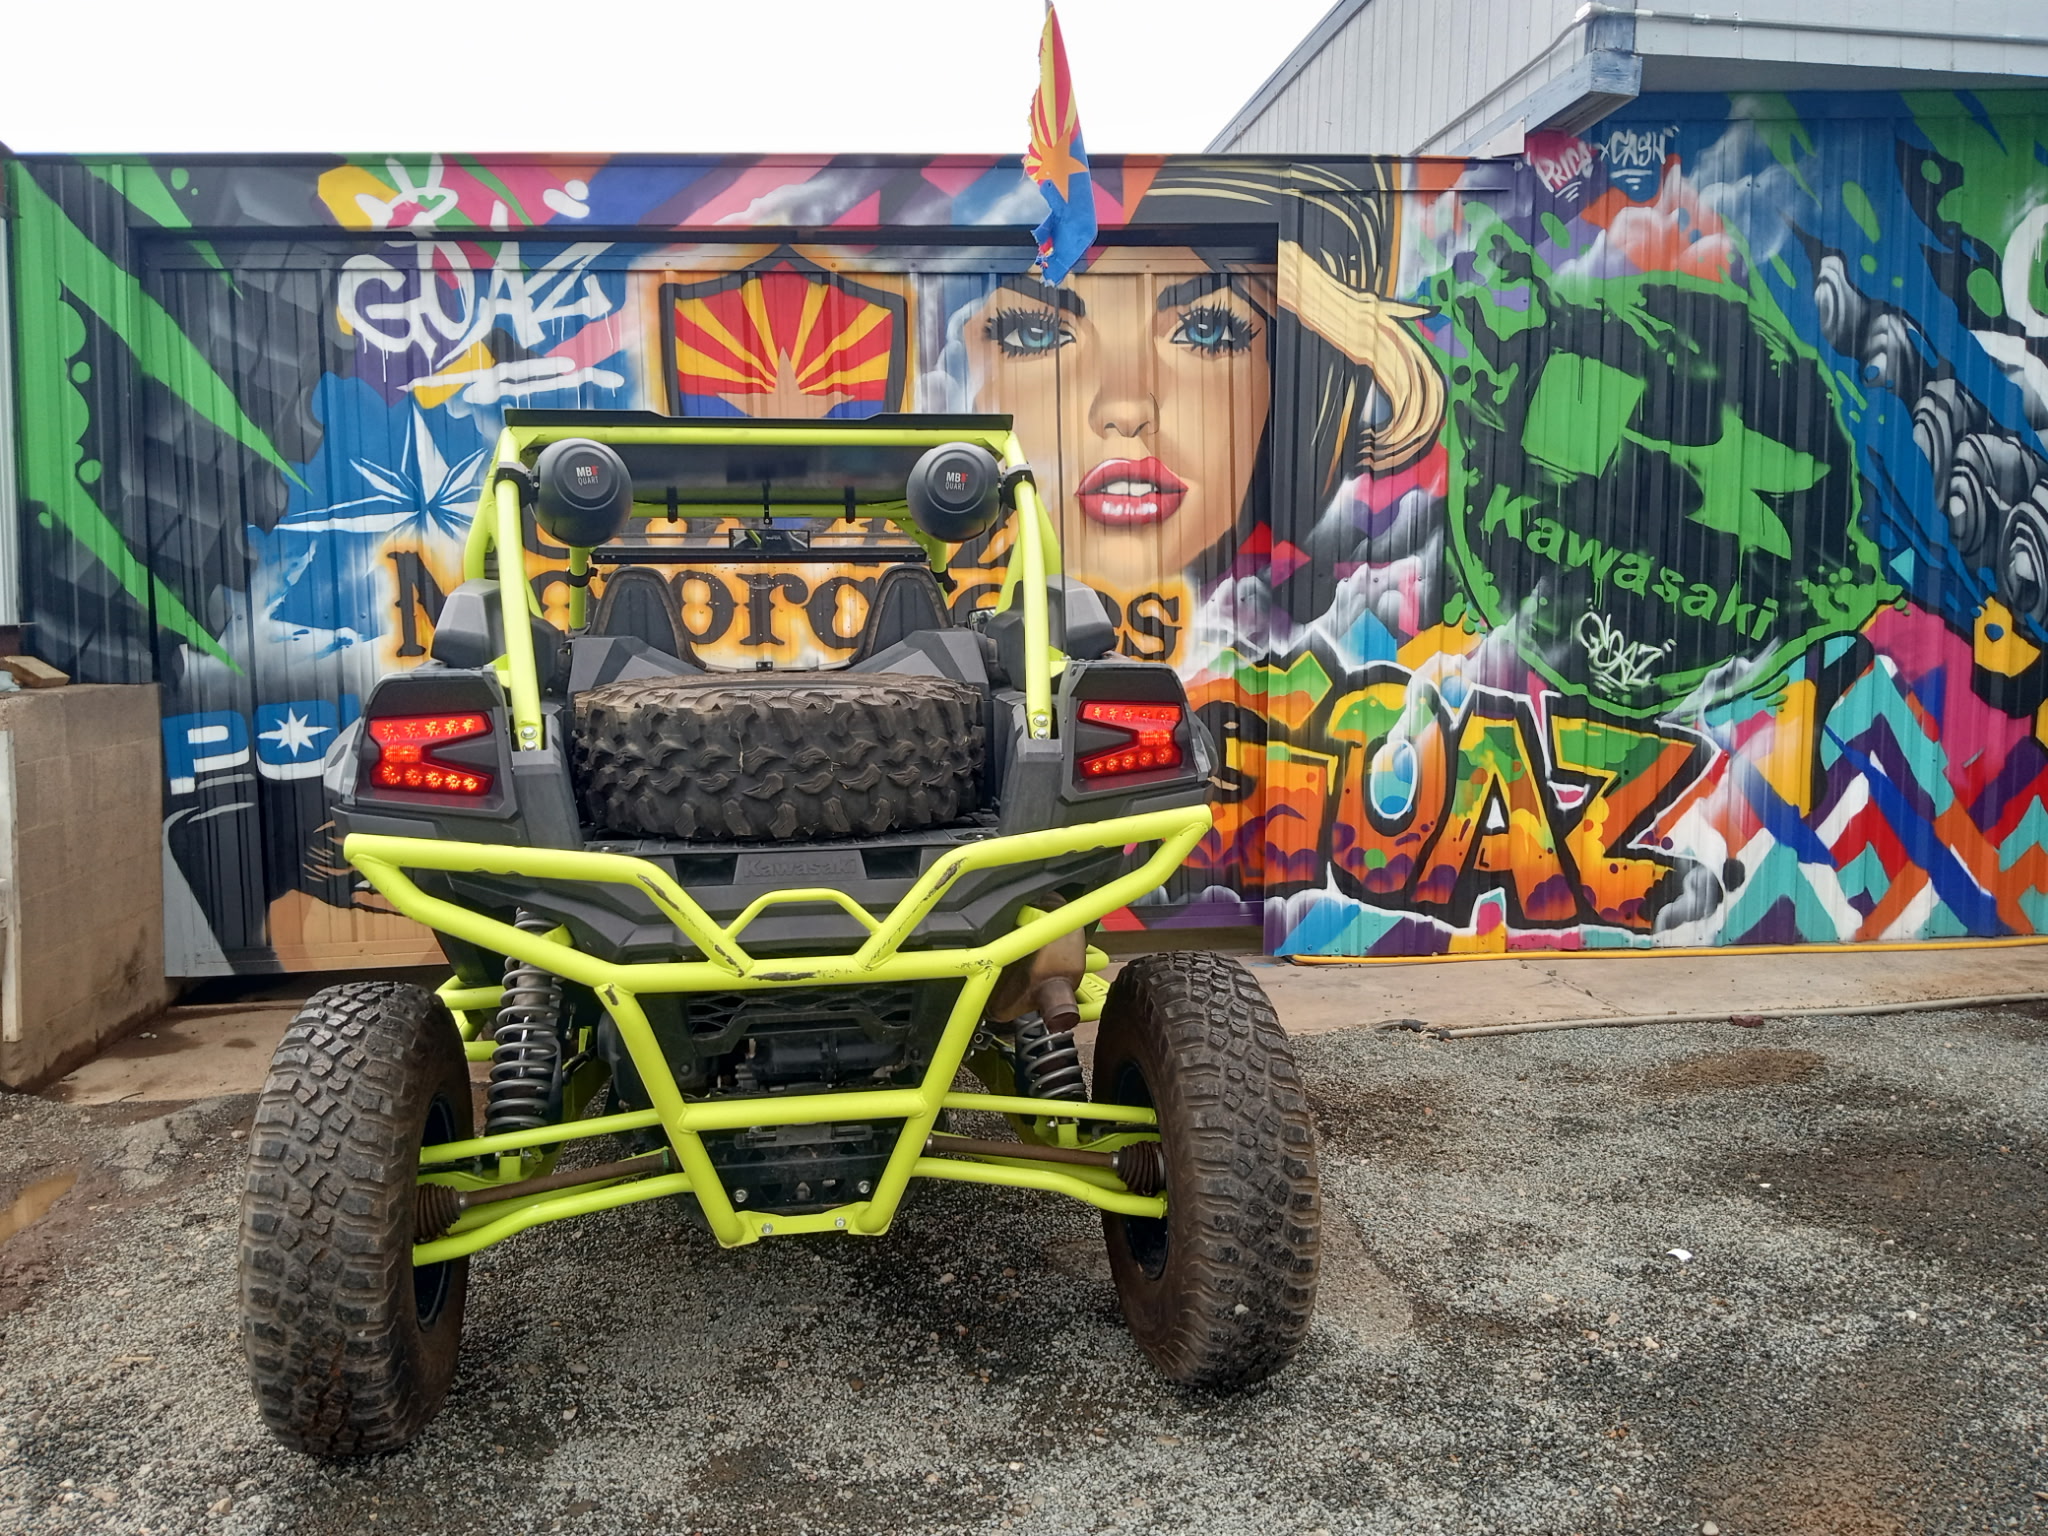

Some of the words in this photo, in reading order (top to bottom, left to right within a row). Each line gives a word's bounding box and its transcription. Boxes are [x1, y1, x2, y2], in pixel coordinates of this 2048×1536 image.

[577, 476, 599, 486] QUART
[945, 481, 966, 491] QUART
[1479, 484, 1779, 641] Kawasaki
[744, 858, 857, 879] Kawasaki
